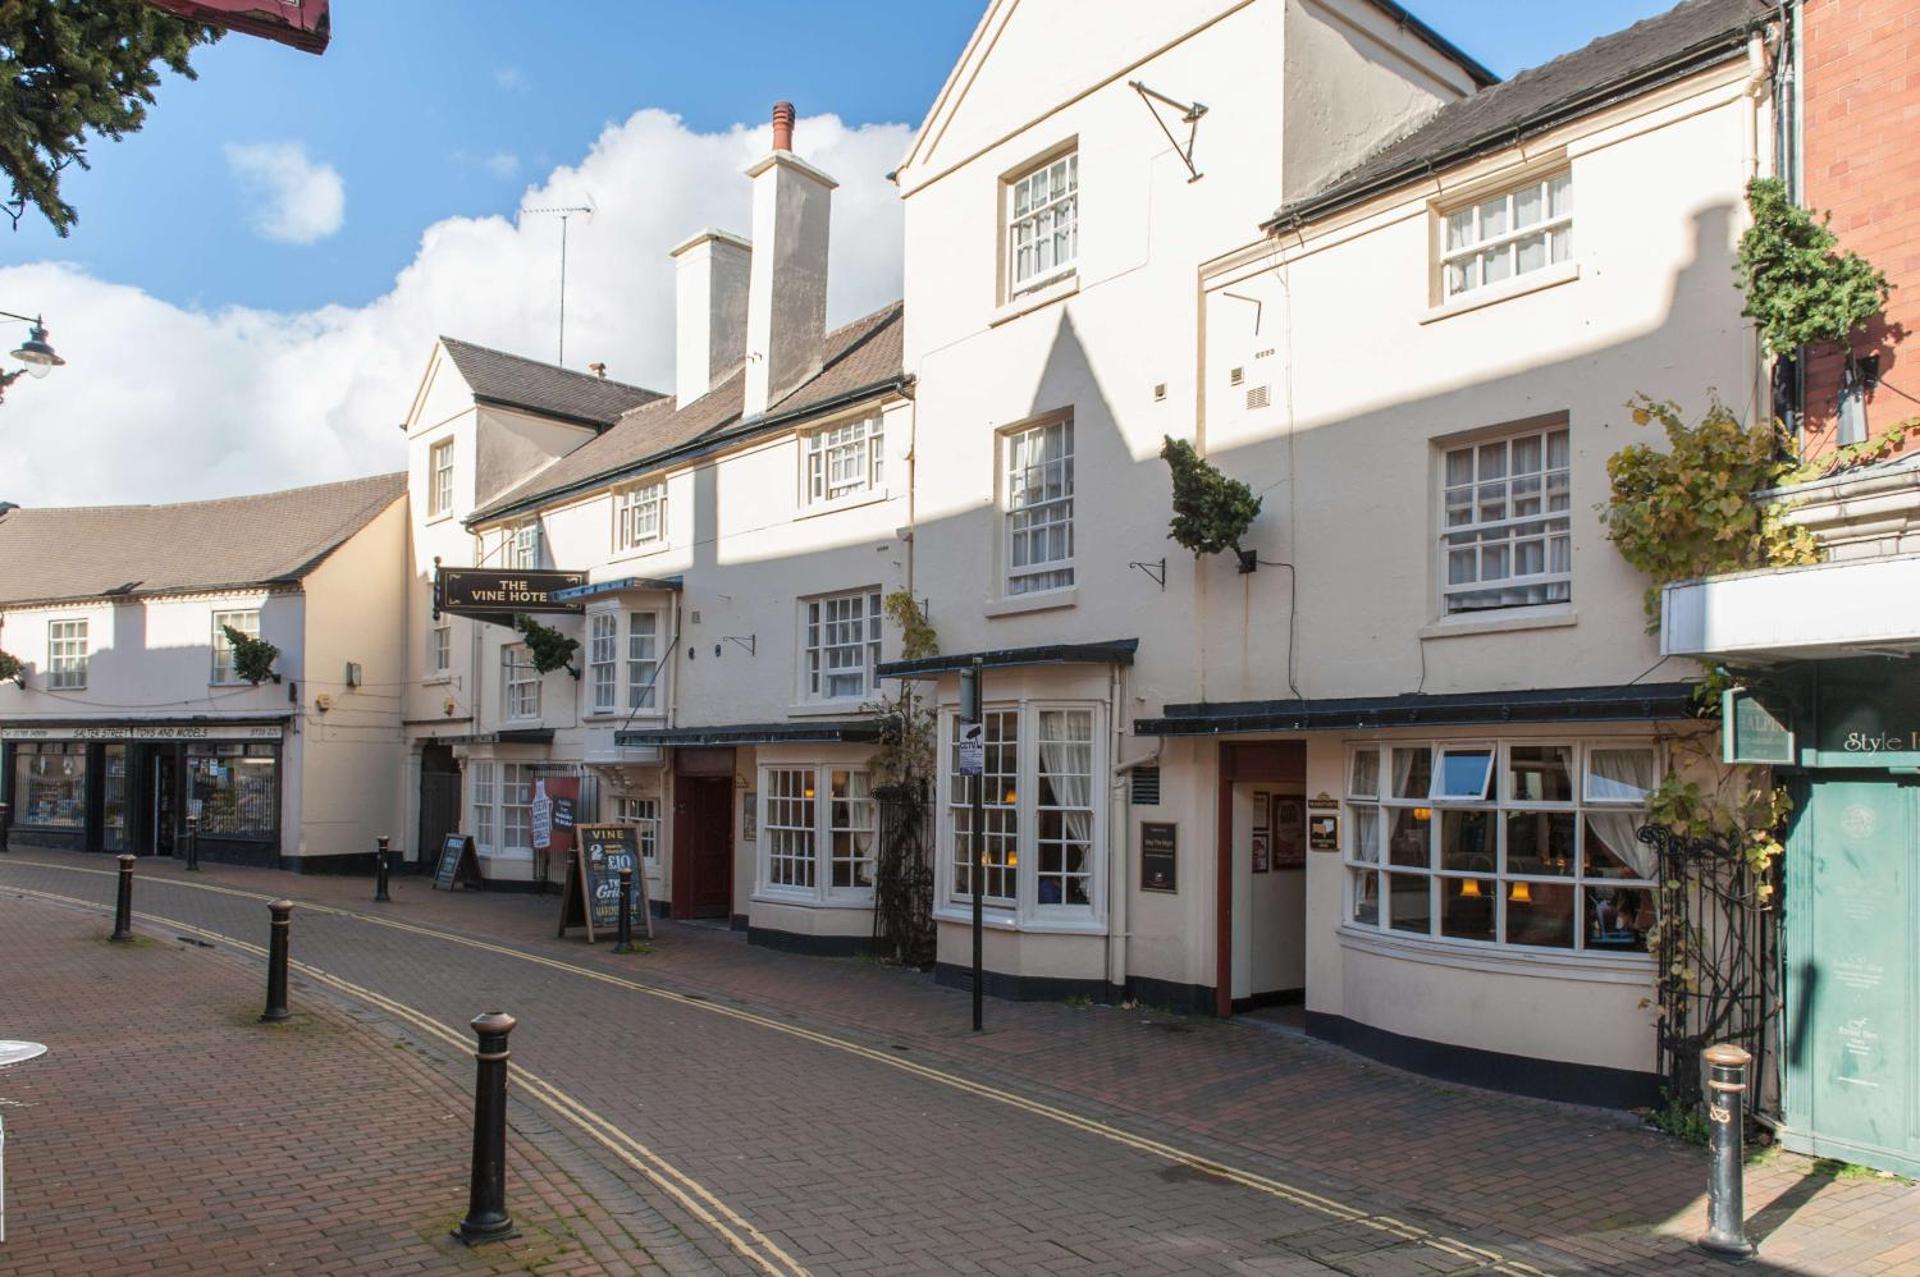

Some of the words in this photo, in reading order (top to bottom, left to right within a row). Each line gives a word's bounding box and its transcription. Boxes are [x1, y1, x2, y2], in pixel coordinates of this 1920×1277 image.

[499, 580, 528, 591] THE
[471, 591, 506, 601] VINE
[509, 591, 548, 603] HOTE
[102, 728, 129, 738] STREET
[136, 727, 156, 737] TOYS
[158, 727, 174, 737] AND
[176, 727, 208, 738] MODELS
[960, 741, 976, 750] CCTV
[1844, 732, 1903, 757] Style
[592, 830, 625, 839] VINE
[590, 843, 603, 861] 2
[607, 854, 632, 871] £10
